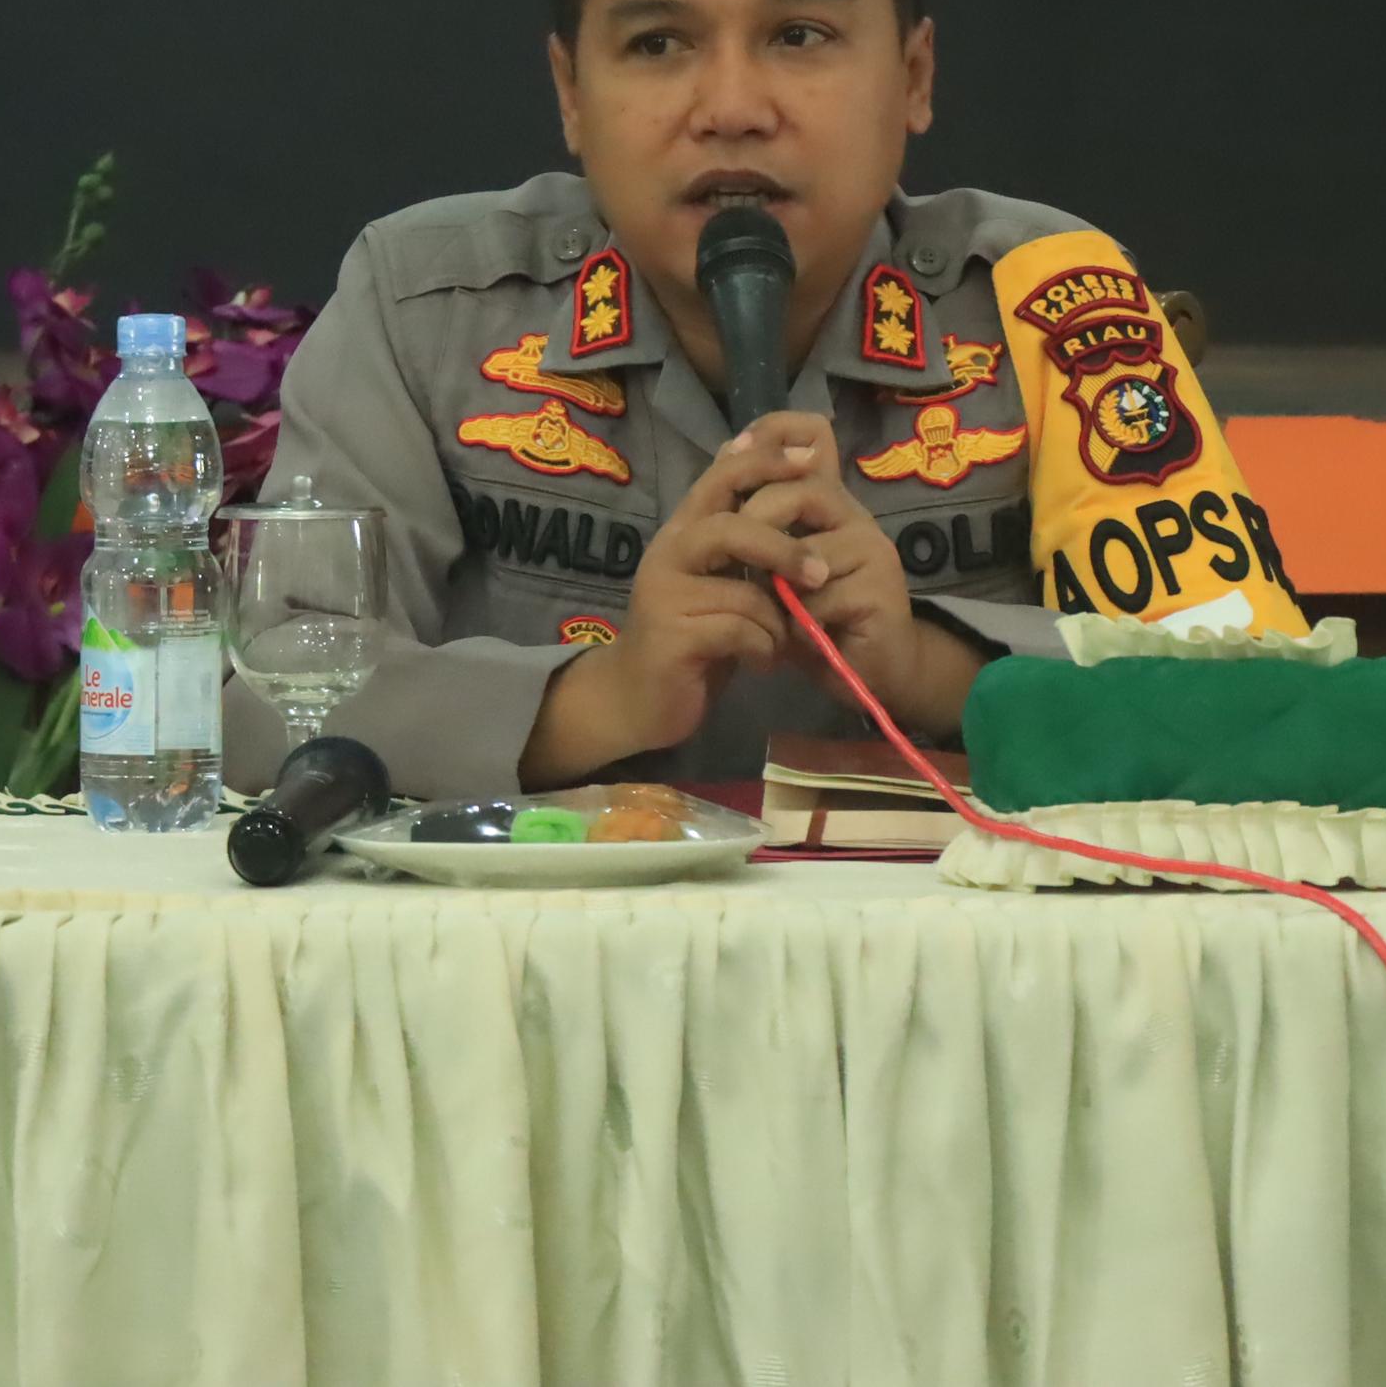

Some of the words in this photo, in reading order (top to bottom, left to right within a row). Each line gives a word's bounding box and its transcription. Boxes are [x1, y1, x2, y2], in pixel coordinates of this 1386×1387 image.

[1029, 273, 1134, 316] POLRES
[1063, 324, 1147, 357] RIAU
[85, 663, 101, 688] Le
